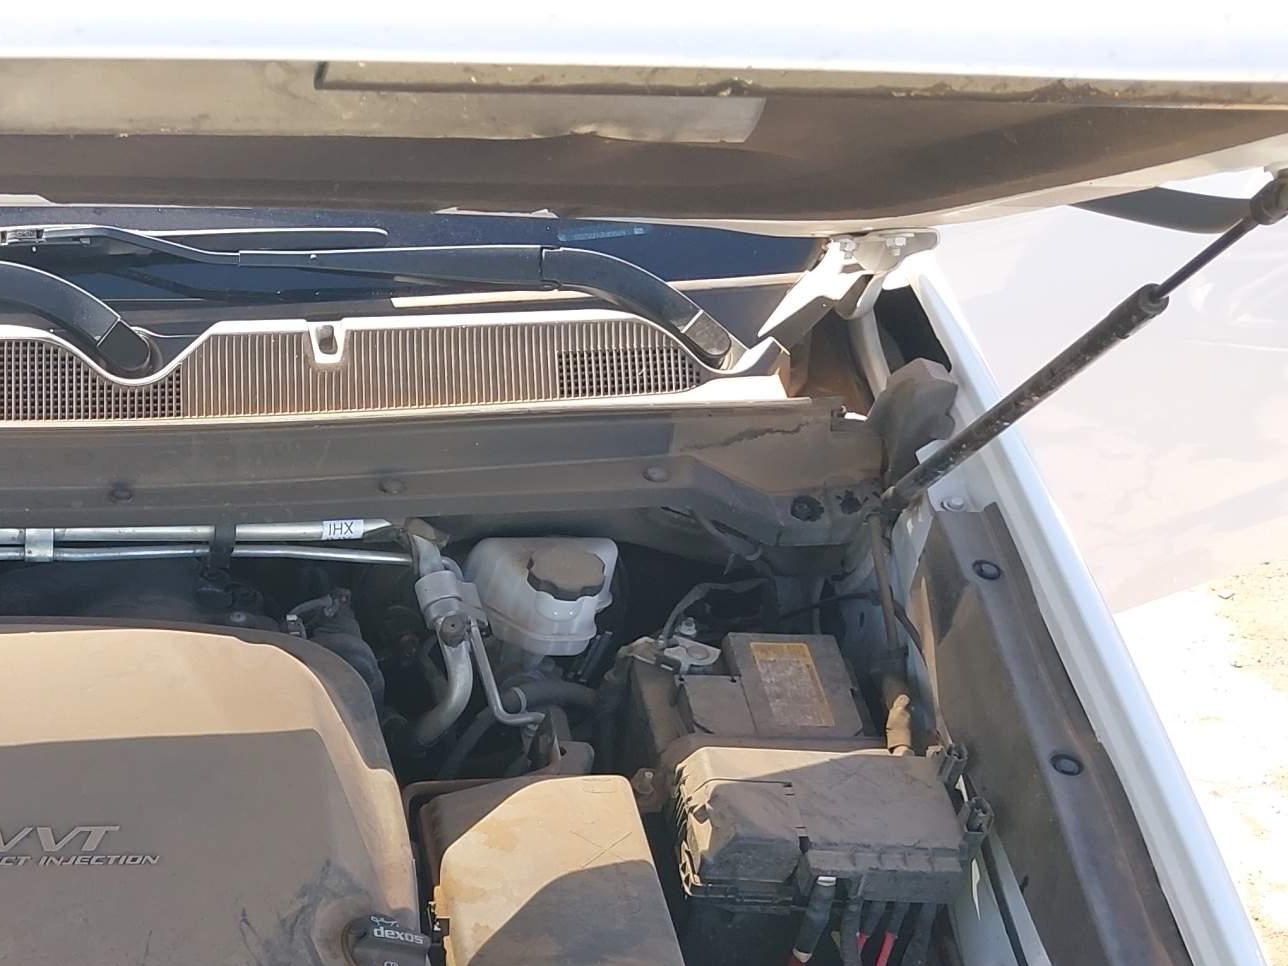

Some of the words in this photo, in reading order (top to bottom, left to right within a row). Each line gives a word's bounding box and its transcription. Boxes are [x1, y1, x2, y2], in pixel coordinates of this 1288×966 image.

[328, 521, 354, 536] IHX
[38, 854, 161, 867] INJECTION
[373, 926, 424, 945] dexos
